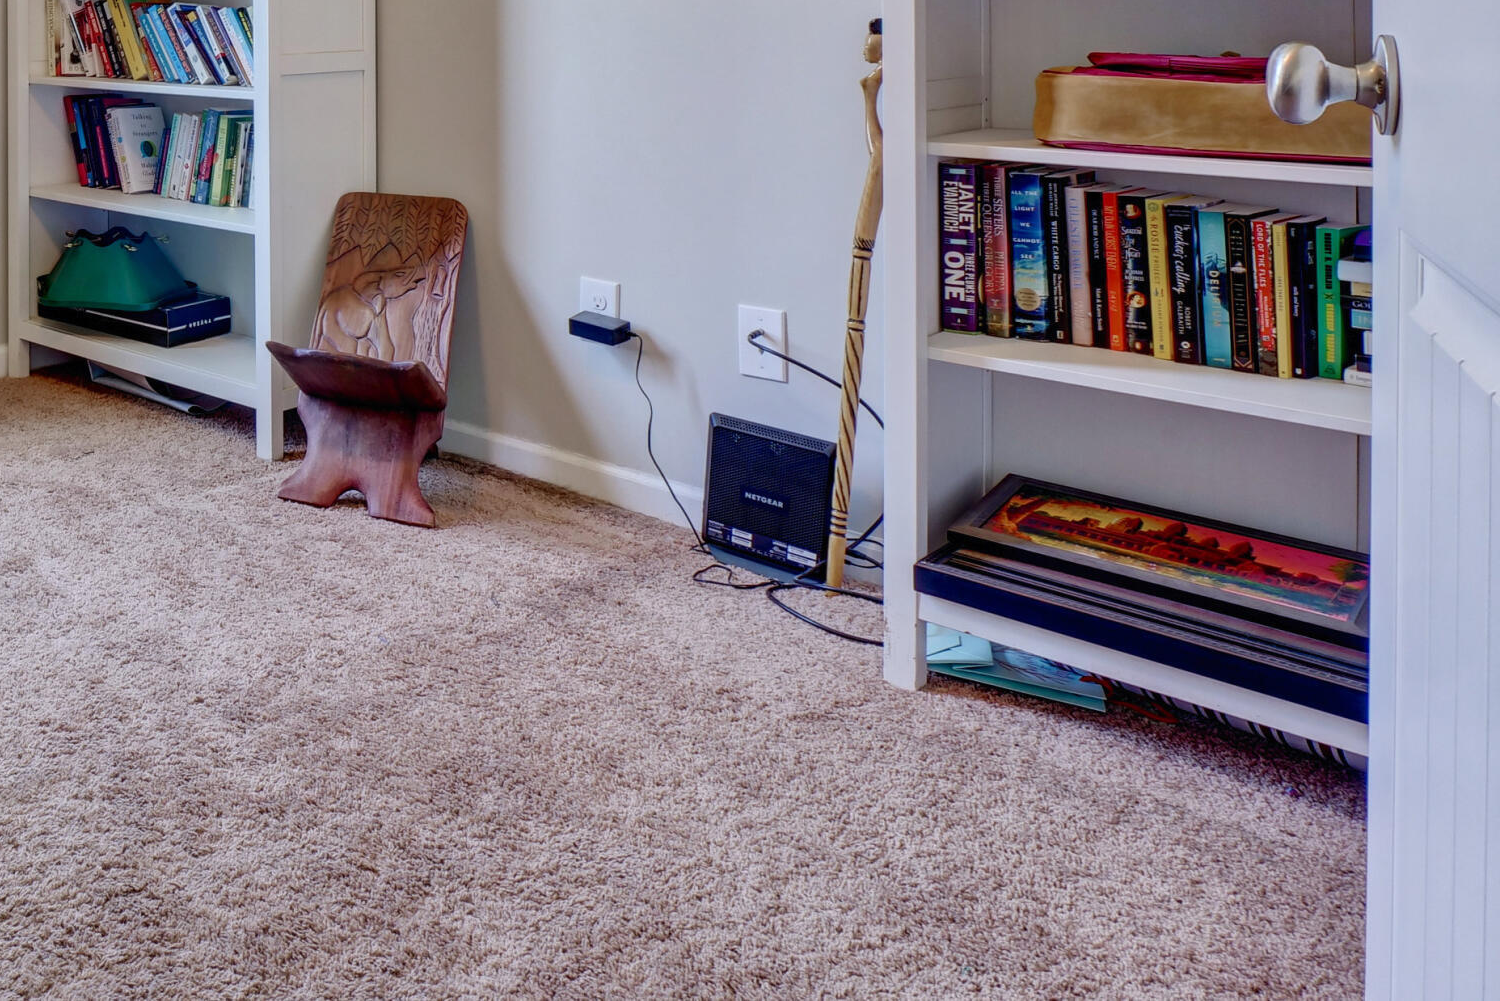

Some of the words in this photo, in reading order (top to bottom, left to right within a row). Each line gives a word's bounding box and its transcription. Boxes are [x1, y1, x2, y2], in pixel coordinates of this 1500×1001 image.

[943, 181, 959, 233] EVANOVICH
[958, 182, 974, 233] JANET
[982, 203, 992, 244] QUEENS
[993, 198, 1004, 236] SISTERS
[1069, 198, 1085, 246] CELESTE
[1104, 206, 1114, 215] MY
[1105, 230, 1116, 251] WORST
[1150, 224, 1160, 253] ROSIE
[1173, 225, 1188, 260] cuckoo's
[1256, 224, 1264, 241] LORD
[1257, 243, 1264, 252] OF
[944, 251, 964, 302] ONE
[965, 253, 975, 272] THREE
[984, 246, 995, 294] GREGORY
[995, 251, 1005, 293] PHILIPPA
[1071, 250, 1085, 289] BARBER
[1107, 252, 1117, 271] ENEMY
[1172, 260, 1190, 294] calling
[1257, 254, 1265, 267] THE
[965, 273, 975, 293] PLUMS
[1258, 269, 1266, 287] FLIES
[1208, 270, 1222, 327] DELIRIUM
[1177, 301, 1185, 334] GALBRAITH
[744, 491, 784, 509] NETGEAR
